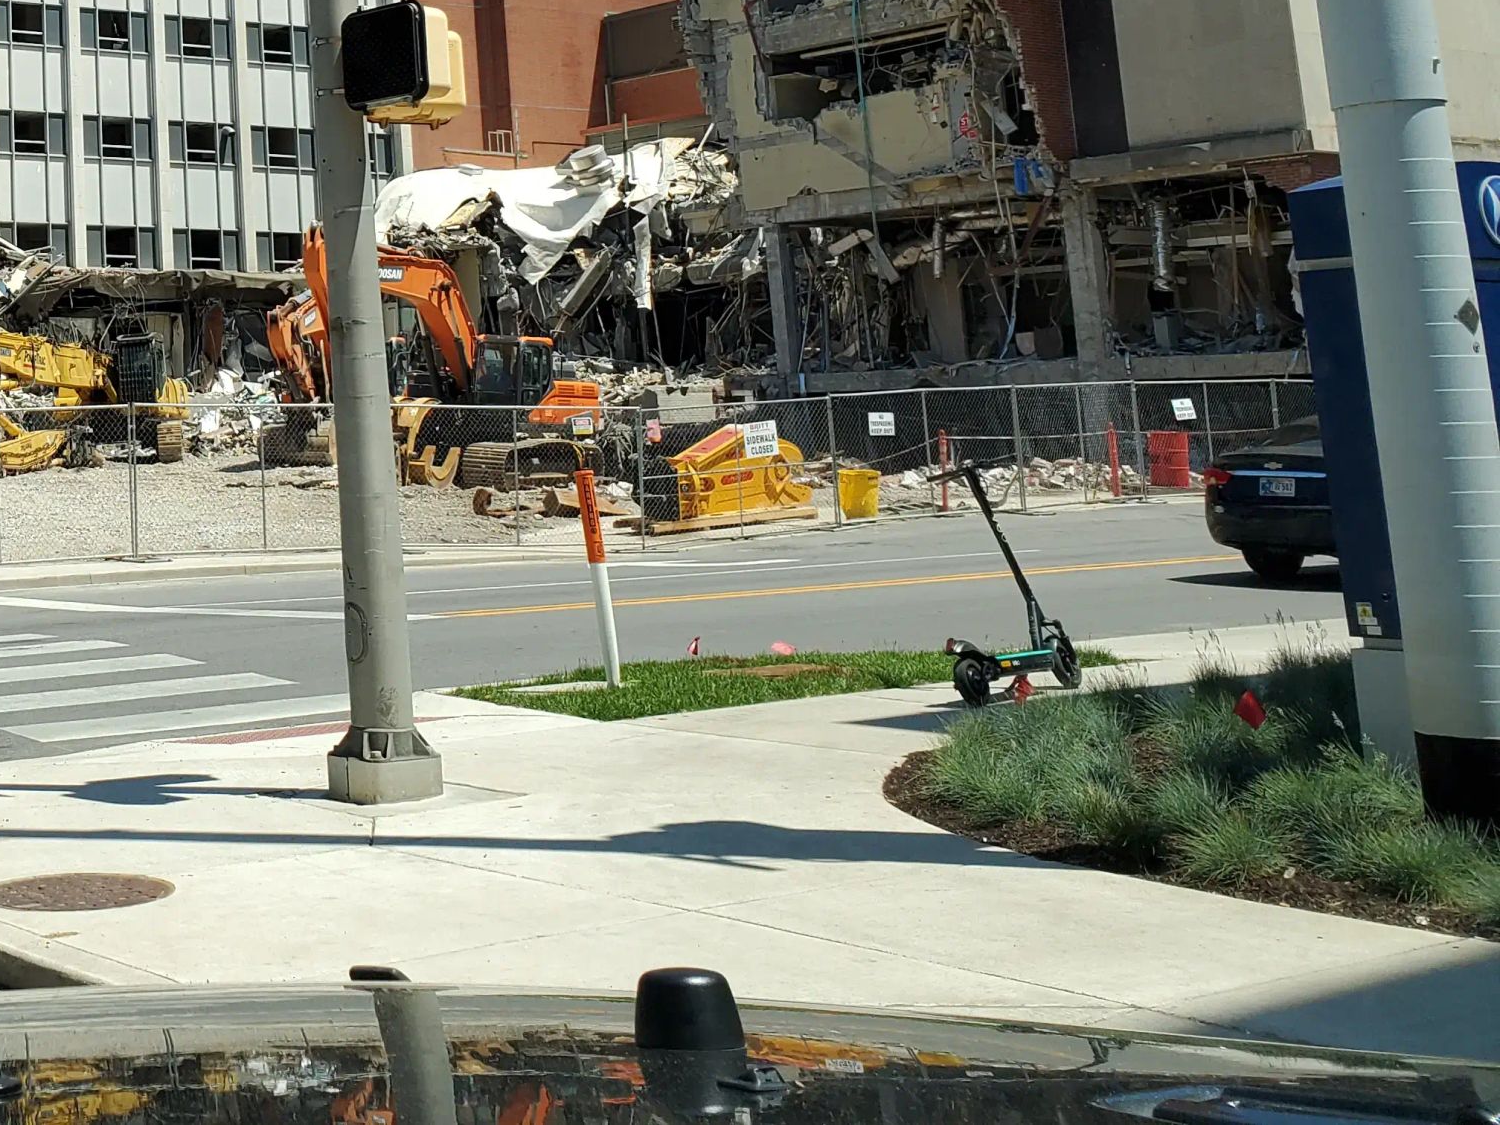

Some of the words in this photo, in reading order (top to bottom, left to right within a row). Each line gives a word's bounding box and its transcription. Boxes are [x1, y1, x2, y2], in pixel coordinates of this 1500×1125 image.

[378, 268, 403, 280] OOSAN
[746, 434, 775, 445] SIDEWALK
[750, 444, 774, 455] CLOSED
[582, 477, 596, 527] WARNING
